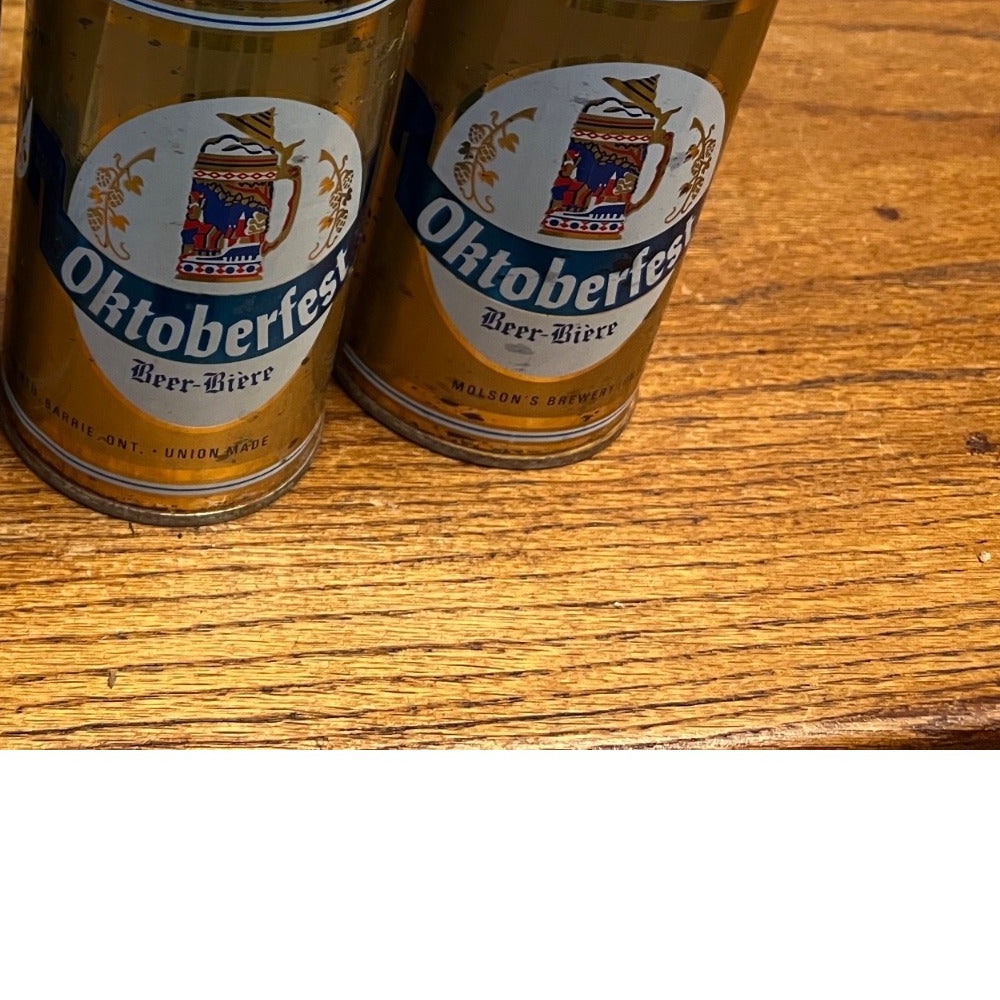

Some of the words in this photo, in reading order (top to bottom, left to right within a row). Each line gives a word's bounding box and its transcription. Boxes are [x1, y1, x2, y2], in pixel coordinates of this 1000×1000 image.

[416, 197, 696, 311] Oktoberfest
[61, 245, 349, 358] Oktoberfest
[451, 378, 540, 407] MOLSON'S
[164, 446, 220, 460] UNION
[225, 435, 270, 456] MADE
